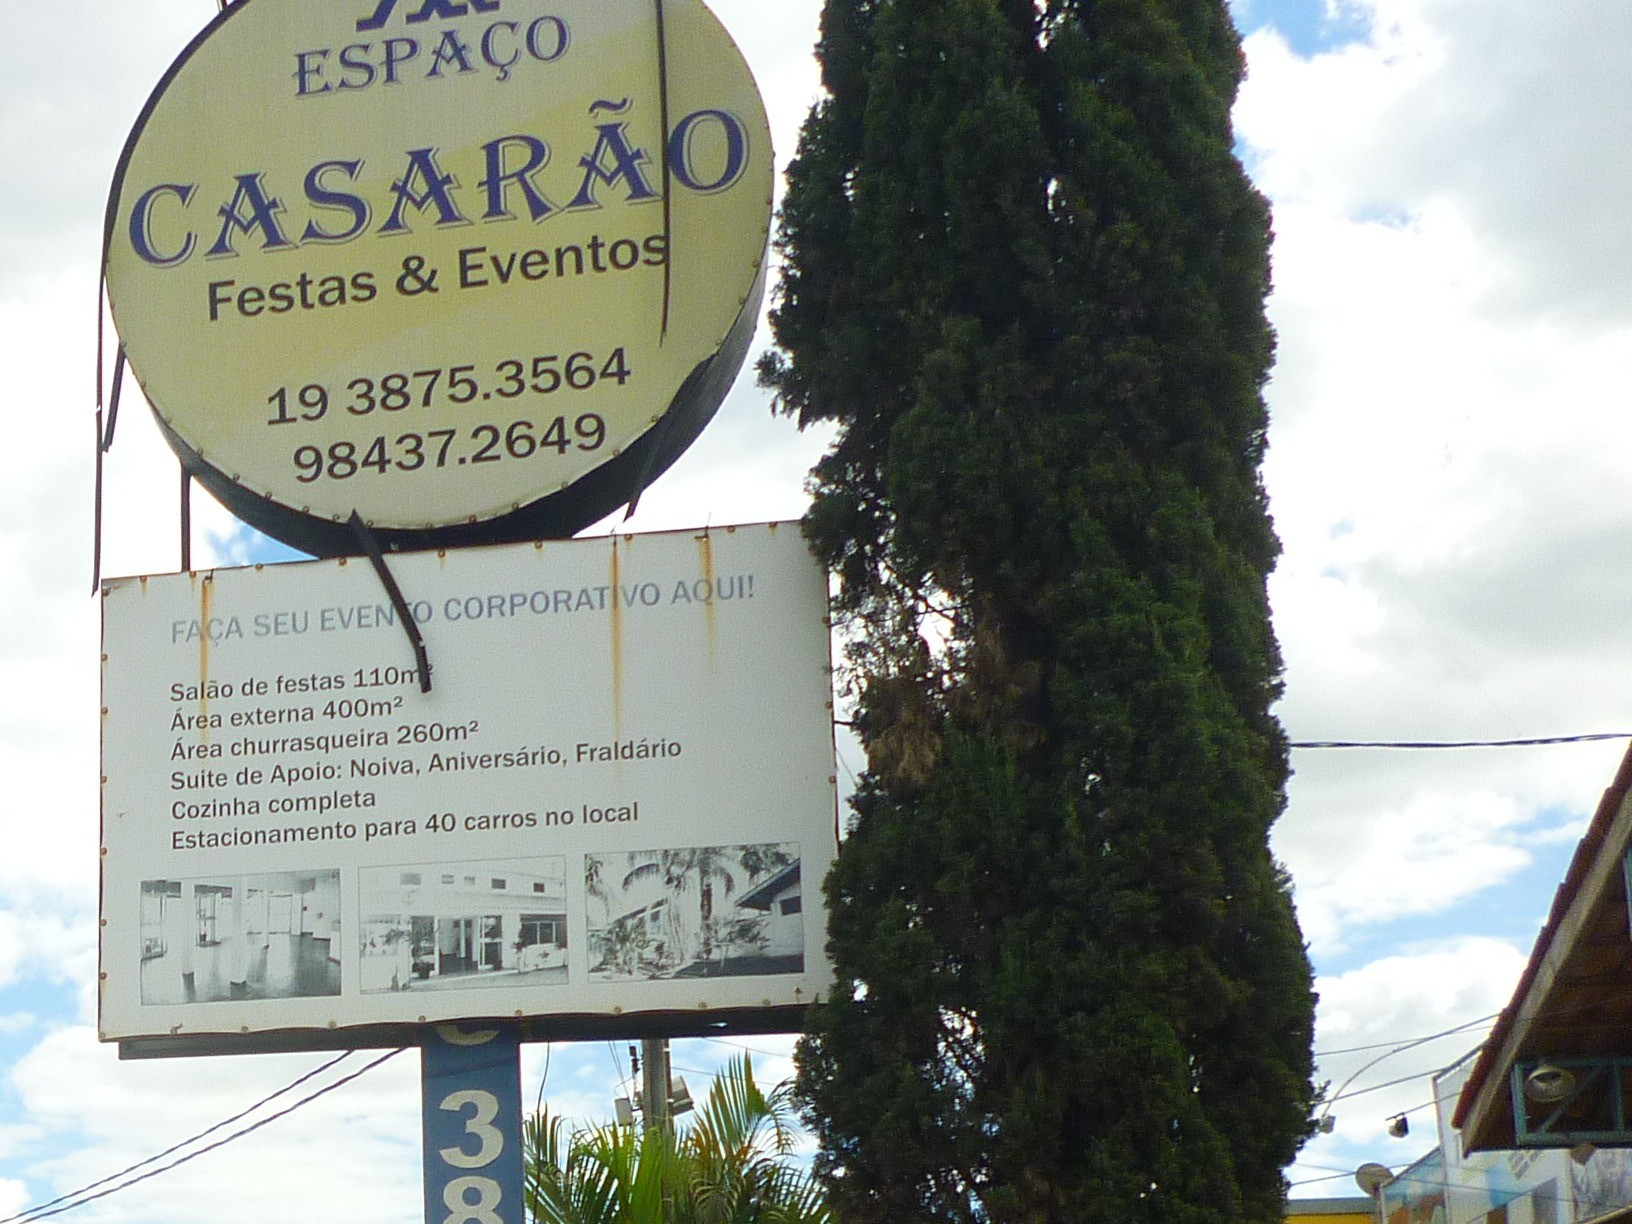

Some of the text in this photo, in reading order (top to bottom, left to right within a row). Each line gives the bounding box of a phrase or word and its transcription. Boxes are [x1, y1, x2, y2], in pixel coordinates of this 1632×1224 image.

[294, 15, 571, 99] ESPAÇO
[129, 98, 751, 268] CASARÃO
[208, 233, 669, 321] Festas & Eventos
[267, 347, 632, 427] 19 3875.3564
[293, 412, 606, 483] 98437.2649
[171, 575, 756, 647] FAÇA SEU EVENO CORPORATIVO AQUI!
[170, 680, 233, 702] Salão
[241, 677, 268, 697] de
[276, 672, 345, 695] festas
[171, 696, 403, 731] Área externa 400m²
[171, 720, 479, 760] Área churrasqueira 260m²
[171, 737, 682, 790] Suite de Apoio: Noiva, Aniversário, Fraldário
[172, 790, 376, 819] Cozinha completa
[172, 801, 638, 850] Estacionamento para 40 carros no local
